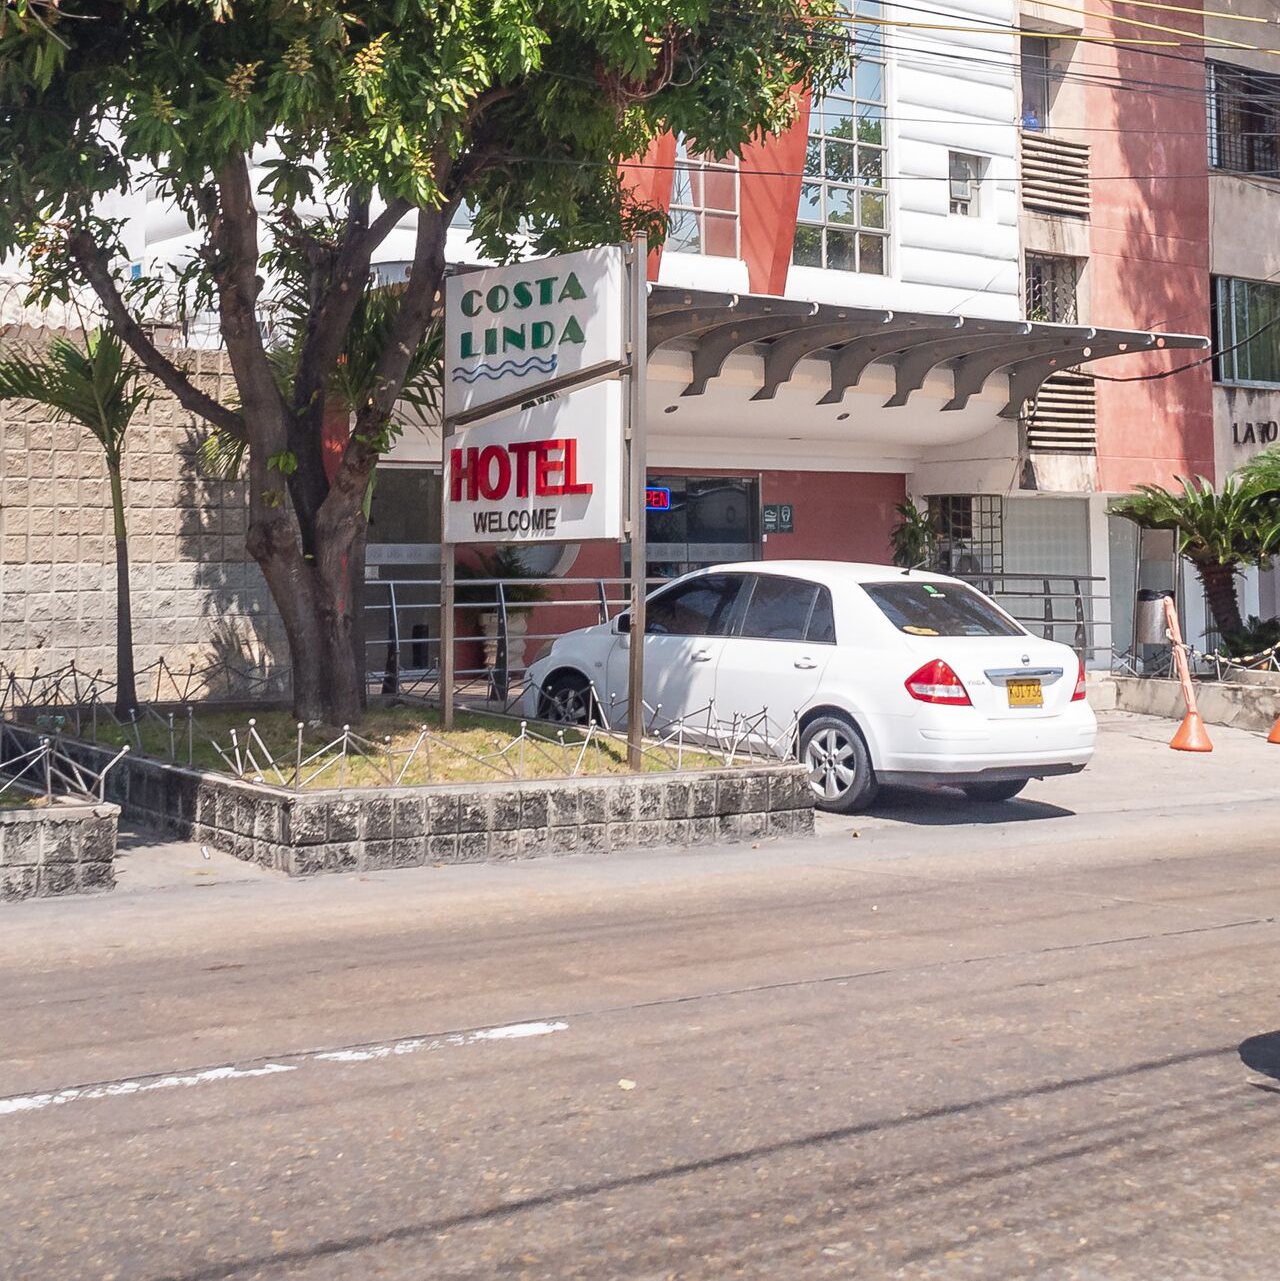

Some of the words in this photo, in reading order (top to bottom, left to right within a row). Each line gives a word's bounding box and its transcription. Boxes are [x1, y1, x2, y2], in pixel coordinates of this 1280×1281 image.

[460, 271, 587, 317] COSTA
[460, 315, 586, 359] LINDA
[450, 438, 593, 502] HOTEL
[473, 507, 557, 534] WELCOME
[646, 490, 668, 507] PEN
